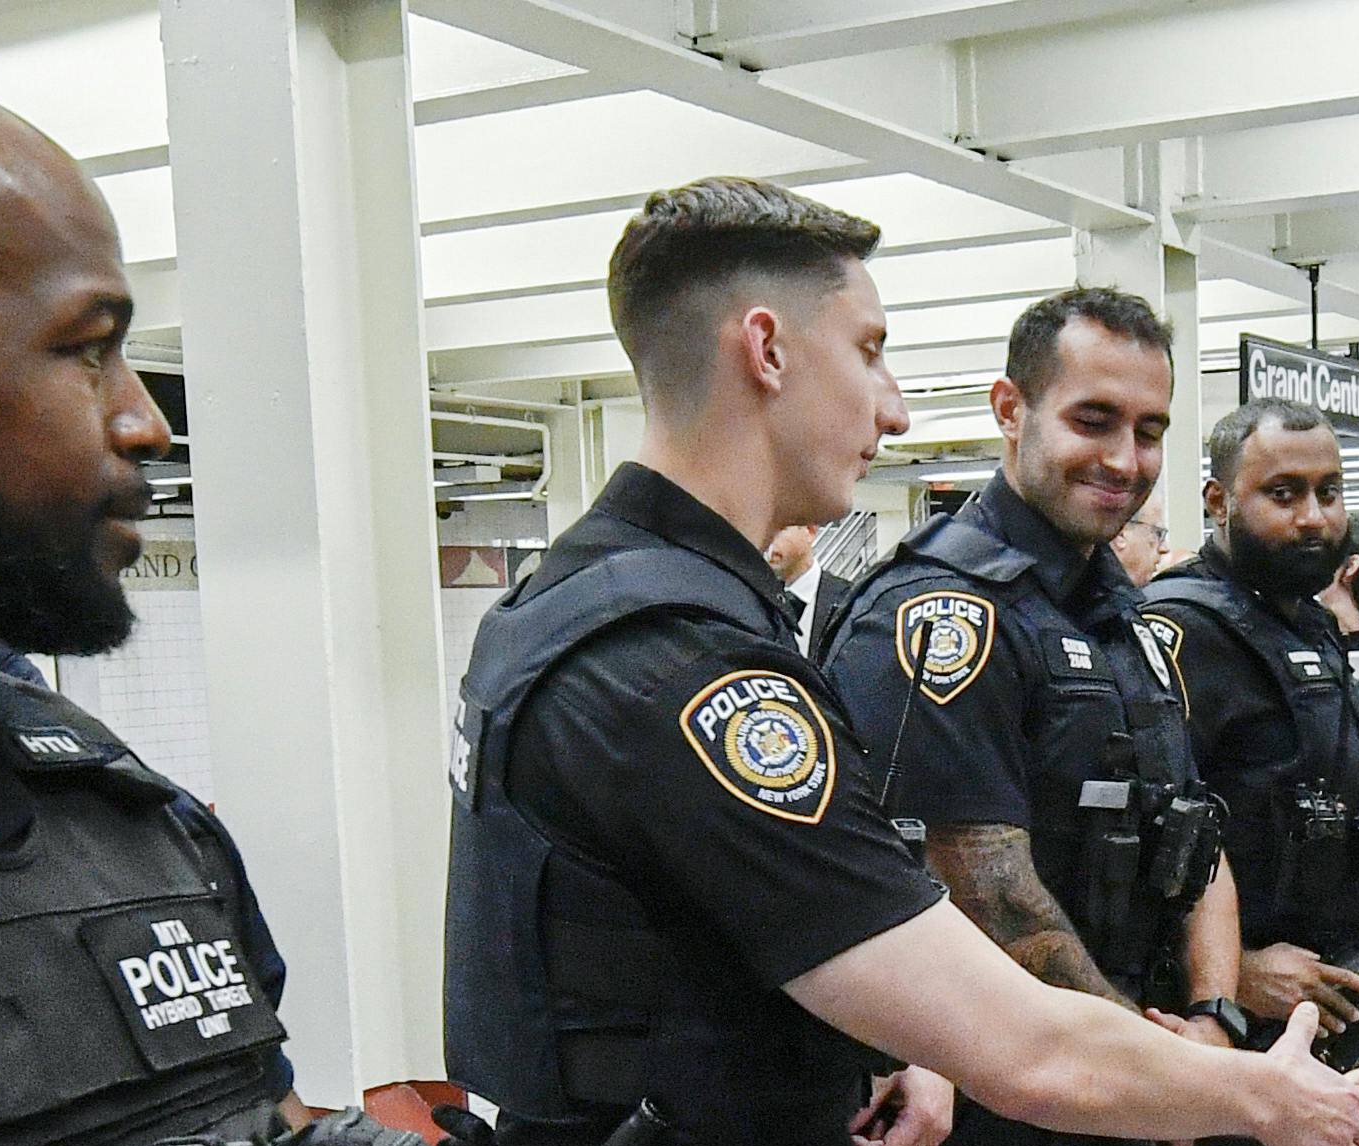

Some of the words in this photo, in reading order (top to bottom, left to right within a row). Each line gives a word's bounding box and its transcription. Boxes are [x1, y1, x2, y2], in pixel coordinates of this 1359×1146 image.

[1249, 350, 1312, 406] Grand
[908, 599, 983, 627] POLICE
[696, 679, 799, 742] POLICE
[20, 735, 80, 753] HTU
[757, 787, 784, 803] NEW
[786, 783, 814, 803] YORK
[807, 760, 827, 789] STATE
[151, 919, 193, 947] MTA
[119, 940, 244, 1006] POLICE
[141, 995, 203, 1030] HYBRID
[196, 1012, 232, 1039] UNIT
